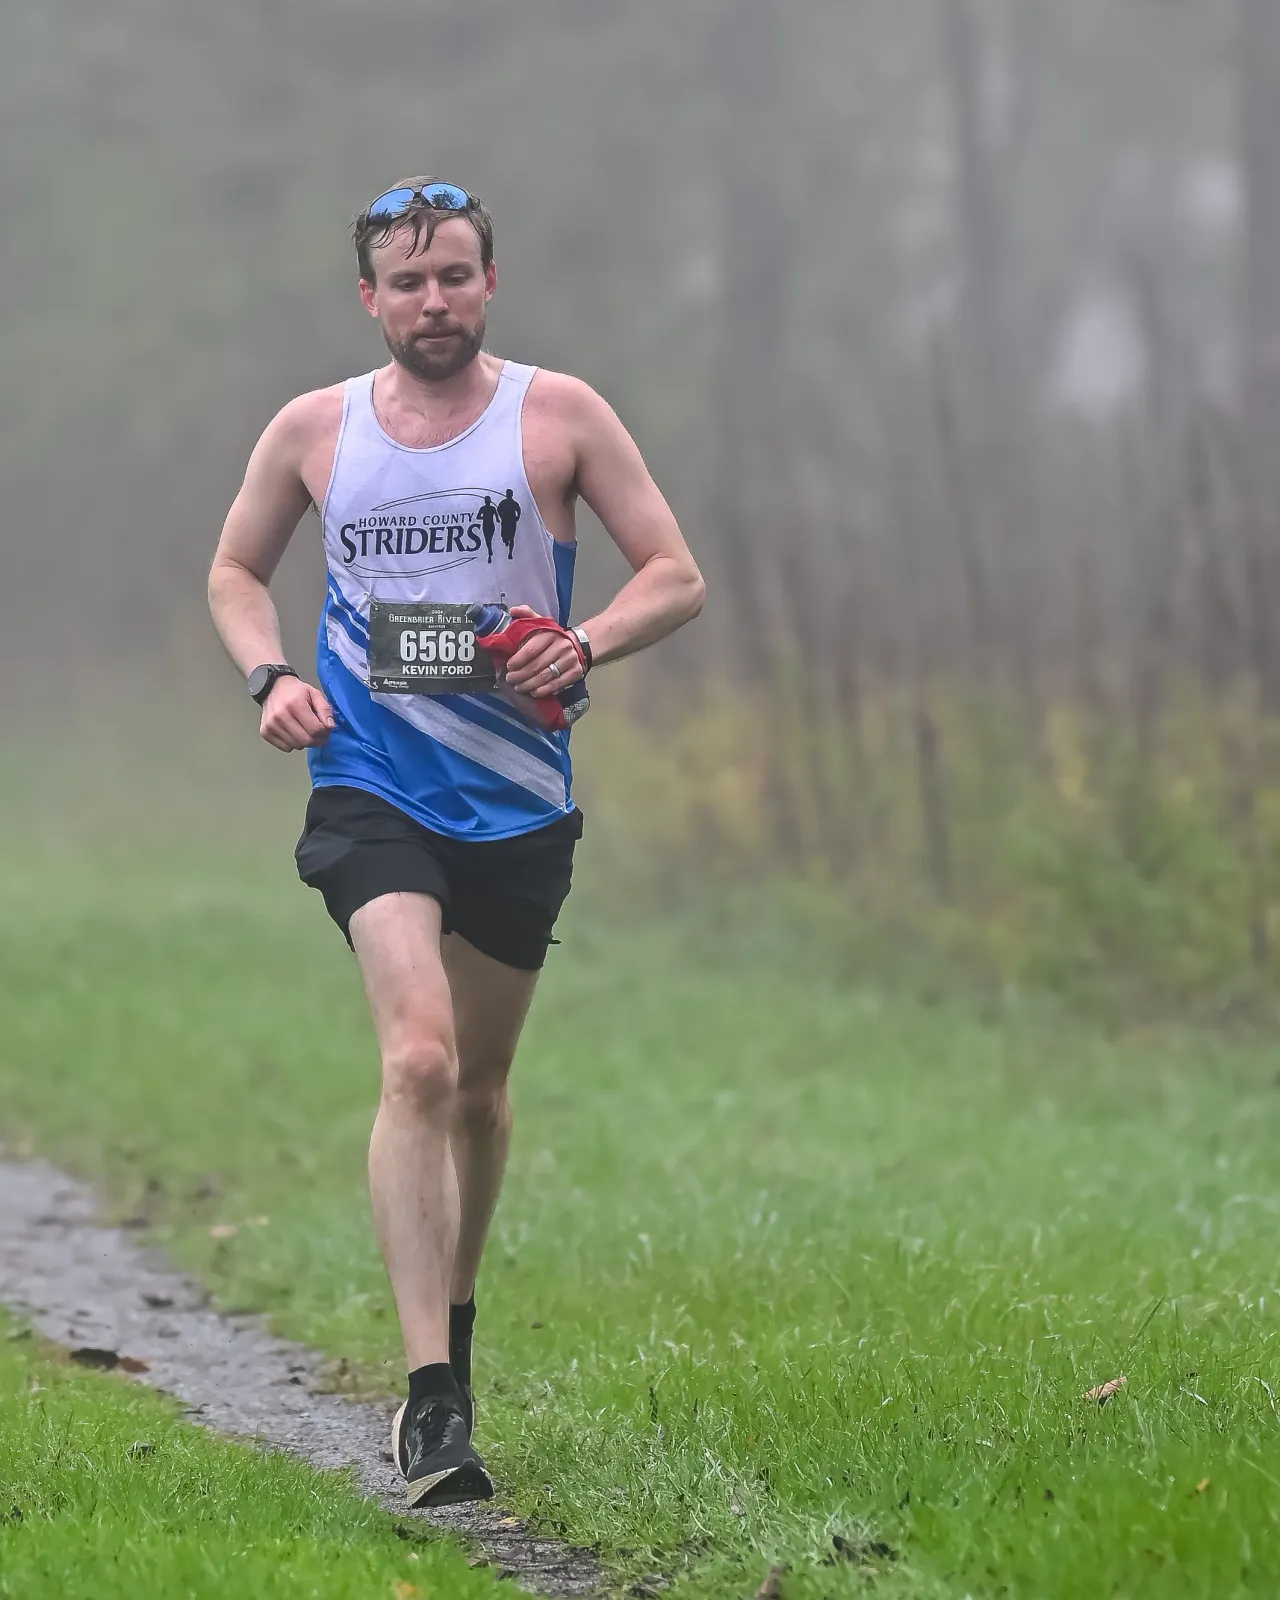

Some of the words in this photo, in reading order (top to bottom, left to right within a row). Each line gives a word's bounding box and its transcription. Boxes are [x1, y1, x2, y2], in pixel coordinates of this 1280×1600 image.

[359, 516, 417, 528] HOWARD
[422, 512, 474, 525] COUNTY
[340, 523, 482, 563] STRIDERS
[389, 614, 434, 623] GREENBRIER
[437, 614, 462, 623] RIVER
[400, 631, 475, 662] 6568
[402, 665, 438, 675] KEVIN
[441, 665, 473, 675] FORD
